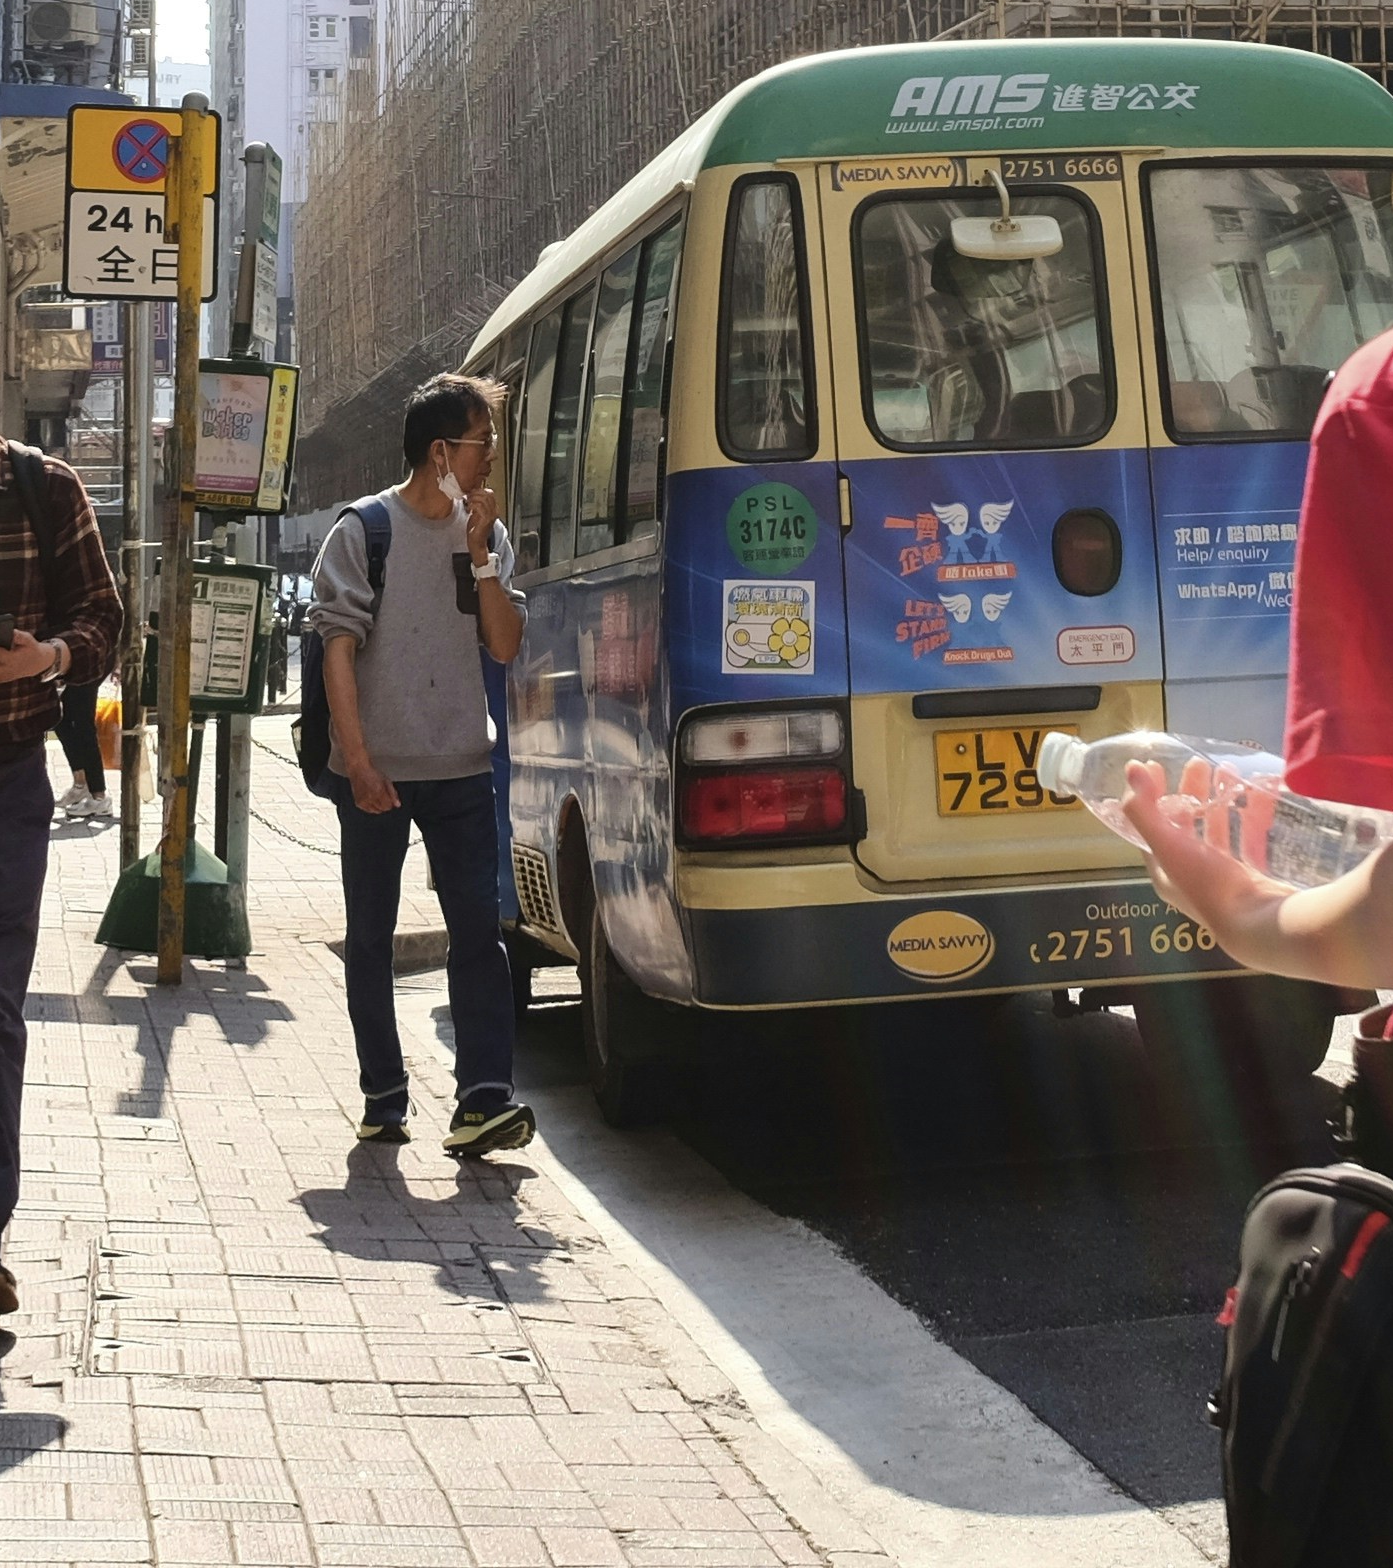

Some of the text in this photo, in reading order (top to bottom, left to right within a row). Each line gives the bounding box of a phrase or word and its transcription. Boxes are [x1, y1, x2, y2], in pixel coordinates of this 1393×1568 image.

[890, 73, 1201, 118] AMS 進智公交
[884, 115, 1046, 135] www.amspt.com
[840, 164, 952, 182] MEDIA SAVVY
[1005, 157, 1119, 179] 2751 6666
[87, 204, 134, 234] 24
[96, 245, 179, 284] 全日
[739, 514, 807, 544] 3174C
[883, 512, 939, 542] 一齊
[1173, 526, 1210, 546] 求助
[1176, 545, 1269, 564] Help/ enquiry
[1068, 633, 1109, 644] EMERGENCY
[1070, 641, 1125, 657] 太平門
[944, 647, 1013, 662] Knock Drugs Out
[974, 730, 1041, 771] LV
[942, 768, 1078, 811] 729
[1085, 901, 1160, 921] Outdoor
[889, 933, 987, 953] MEDIA SAVVY
[1046, 922, 1217, 963] 2751 666
